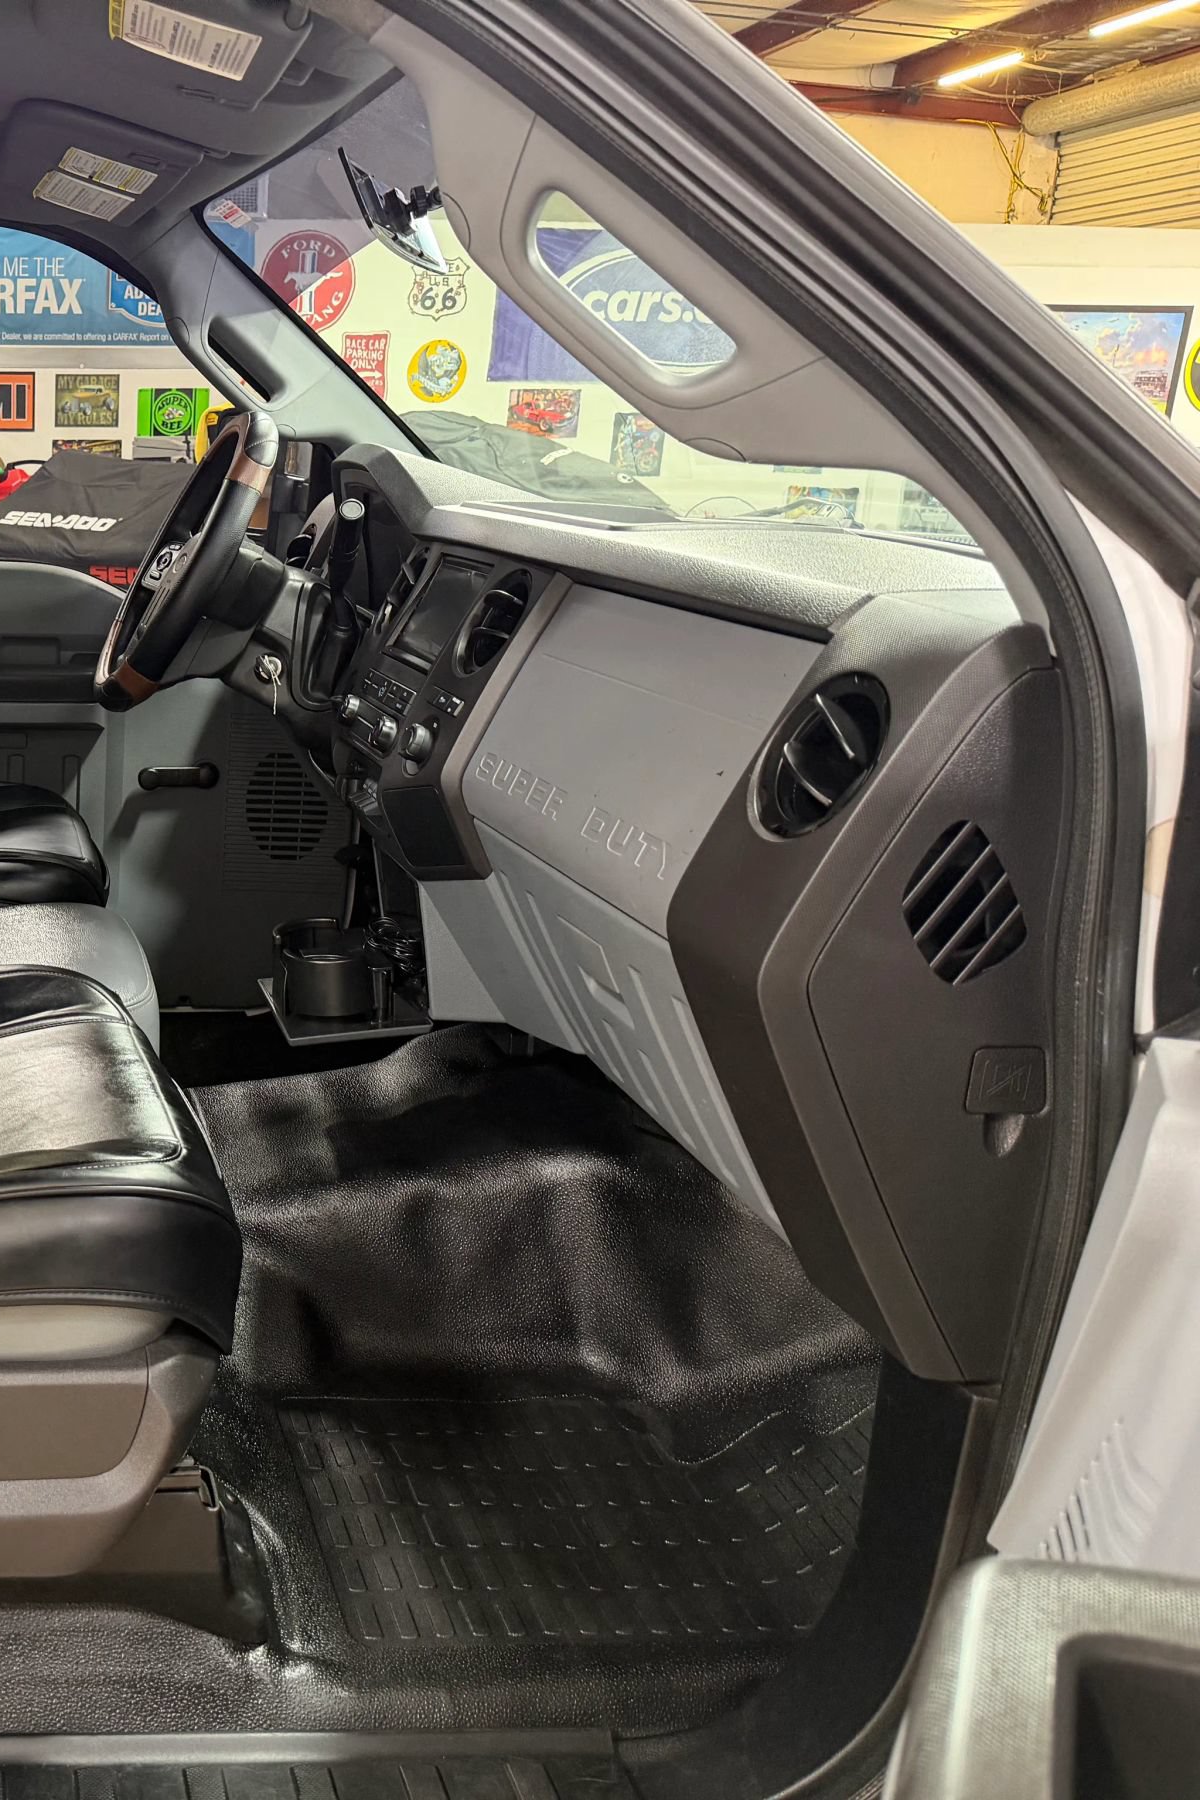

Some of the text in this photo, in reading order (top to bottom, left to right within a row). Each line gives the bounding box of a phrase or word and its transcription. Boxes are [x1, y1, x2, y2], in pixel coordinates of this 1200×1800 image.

[281, 240, 336, 259] FORD
[3, 257, 29, 277] ME
[33, 257, 65, 277] THE
[420, 287, 457, 310] 66
[302, 291, 344, 325] TANG
[112, 332, 137, 341] CARFAX
[346, 338, 386, 350] RACE CAR
[346, 348, 383, 361] PARKING
[351, 358, 377, 369] ONLY
[57, 376, 118, 389] MY GARAGE
[158, 396, 188, 411] SUPER
[57, 411, 117, 425] MY RULES!
[161, 420, 183, 430] BEE
[476, 752, 672, 880] SUPER DUTY
